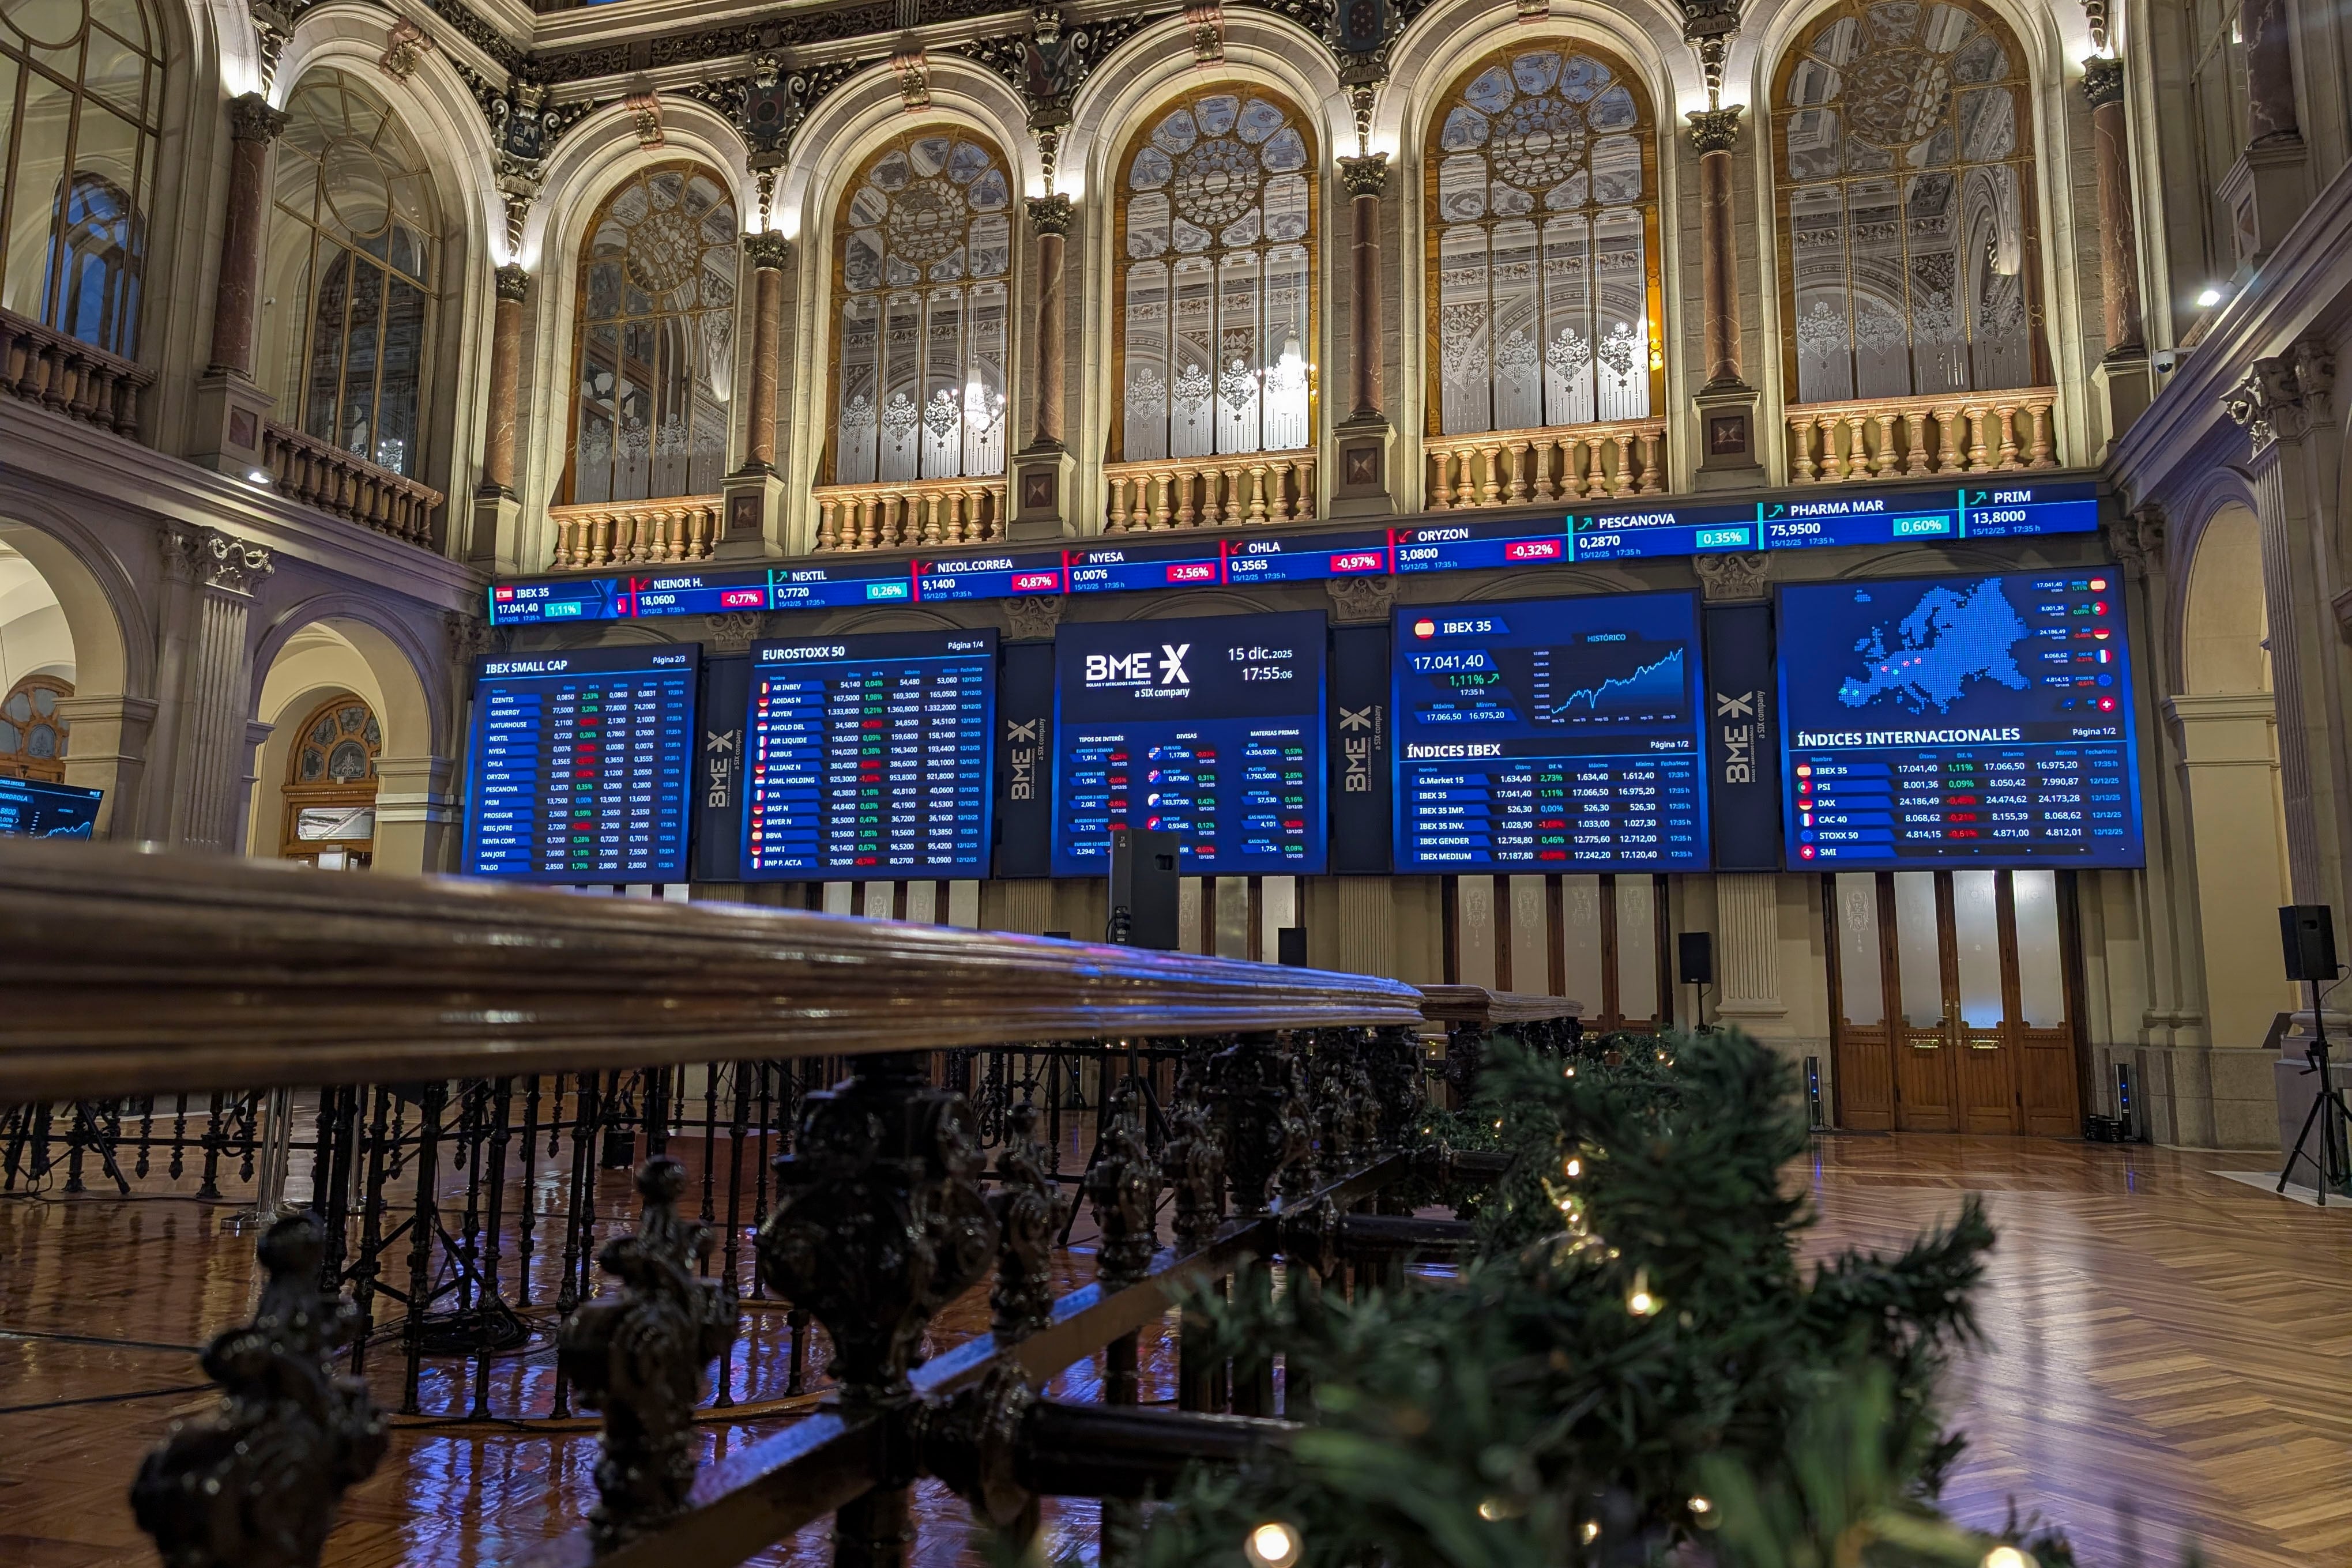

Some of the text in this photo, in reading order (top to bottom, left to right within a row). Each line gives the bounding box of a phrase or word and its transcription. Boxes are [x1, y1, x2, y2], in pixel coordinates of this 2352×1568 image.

[1692, 20, 1730, 33] HOLANDA
[1994, 490, 2031, 503] PRIM
[1790, 500, 1884, 517] PHARMA MAR
[1599, 513, 1676, 529] PESCANOVA
[1973, 510, 2026, 525] 13,8000
[1770, 522, 1821, 537] 75,9500
[1901, 519, 1942, 533] 0,60%
[1972, 526, 2005, 535] 15/12/25
[1418, 527, 1469, 542] ORYZON
[1703, 530, 1743, 545] 0,35%
[1248, 541, 1281, 553] OHLA
[1579, 535, 1620, 549] 0,2870
[1771, 538, 1801, 546] 15/12/25
[1400, 548, 1438, 561] 3,0800
[1512, 544, 1553, 557] -0,32%
[1089, 552, 1124, 563] NYESA
[1337, 556, 1375, 570] -0,97%
[938, 559, 1013, 573] NICOL.CORREA
[1232, 559, 1268, 572] 0,3565
[792, 570, 827, 582] NEXTIL
[1074, 569, 1108, 582] 0,0076
[1173, 567, 1209, 579] -2,56%
[653, 578, 703, 590] NEINOR H.
[922, 578, 955, 591] 9,1400
[1018, 576, 1052, 588] -0,87%
[516, 587, 550, 598] IBEX 35
[777, 587, 810, 599] 0,7720
[872, 584, 902, 597] 0,26%
[641, 594, 675, 606] 18,0600
[727, 593, 758, 605] -0,77%
[498, 602, 539, 614] 17.041,40
[548, 604, 577, 615] 1,11%
[1443, 620, 1492, 634] IBEX 35
[1587, 634, 1626, 642] HISTÓRICO
[948, 642, 971, 651] Página
[762, 646, 845, 660] EUROSTOXX 50
[1228, 647, 1244, 661] 15
[653, 656, 674, 665] Página
[1086, 652, 1151, 681] BME
[1414, 654, 1484, 670] 17.041,40
[486, 660, 567, 674] IBEX SMALL CAP
[1450, 674, 1484, 687] 1,11%
[1141, 688, 1154, 698] SIX
[1154, 688, 1190, 699] company
[1758, 691, 1766, 721] company
[1427, 713, 1462, 721] 17.066,50
[1469, 711, 1504, 719] 16.975,20
[1797, 728, 2020, 747] ÍNDICES INTERNACIONALES
[2072, 728, 2101, 737] Página
[782, 737, 807, 745] LIQUIDE
[1650, 741, 1675, 750] Página
[1407, 743, 1501, 758] ÍNDICES IBEX
[1725, 725, 1749, 783] BME
[1345, 737, 1366, 791] BME
[1898, 764, 1937, 773] 17.041,40
[1948, 763, 1973, 772] 1,11%
[1984, 762, 2025, 771] 17.066,50
[2036, 761, 2078, 770] 16.975,20
[1011, 748, 1030, 800] BME
[1500, 775, 1531, 783] 1.634,40
[1540, 774, 1563, 782] 2,73%
[709, 758, 727, 807] BME
[1419, 777, 1454, 785] G.Market
[1817, 783, 1831, 791] PSI
[1903, 781, 1939, 789] 8.001,36
[1948, 780, 1974, 789] 0,09%
[1990, 778, 2026, 787] 8.050,42
[1819, 816, 1835, 824] CAC
[1819, 831, 1858, 840] STOXX 50
[1820, 848, 1837, 856] SMI
